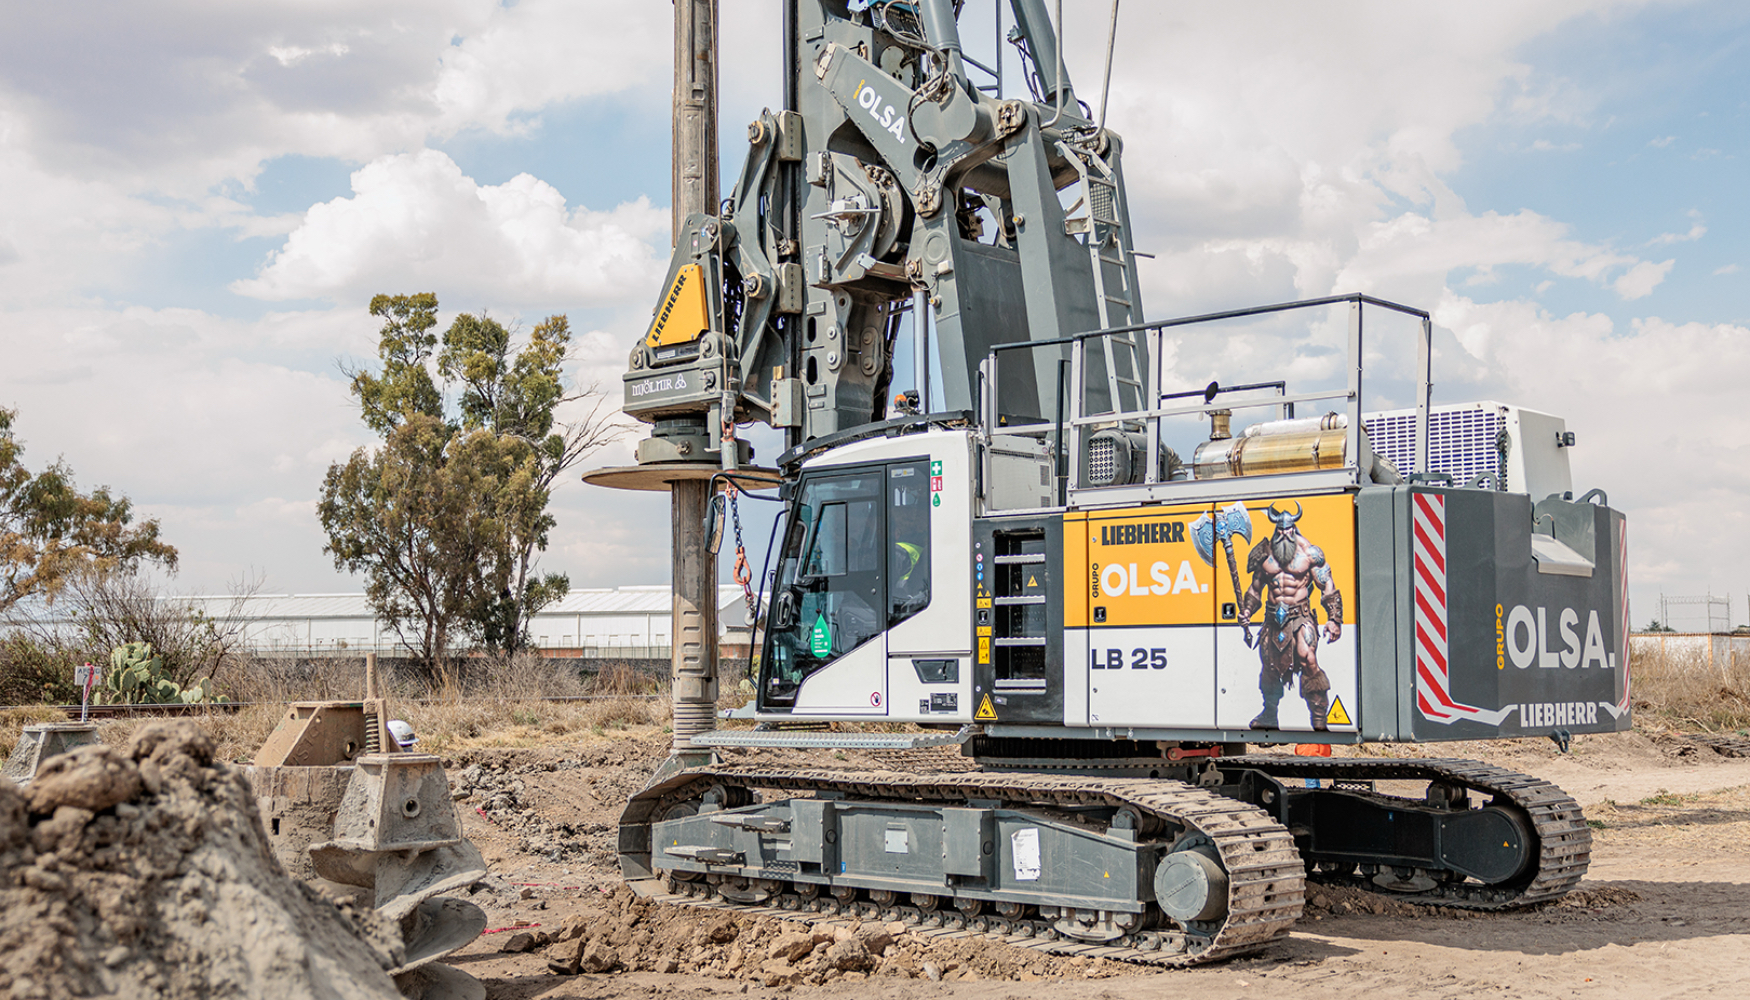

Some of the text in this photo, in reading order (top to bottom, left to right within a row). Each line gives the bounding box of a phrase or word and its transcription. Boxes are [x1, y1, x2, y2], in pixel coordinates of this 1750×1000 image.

[858, 86, 906, 144] OLSA.
[651, 274, 687, 342] LIEBHERR
[1101, 521, 1185, 546] LIEBHERR
[1092, 562, 1100, 598] GRUPO
[1100, 560, 1209, 598] OLSA.
[1495, 603, 1505, 670] GRUPO
[1506, 604, 1616, 669] OLSA.
[1091, 647, 1168, 670] LB 25
[1520, 701, 1598, 728] LIEBHERR
